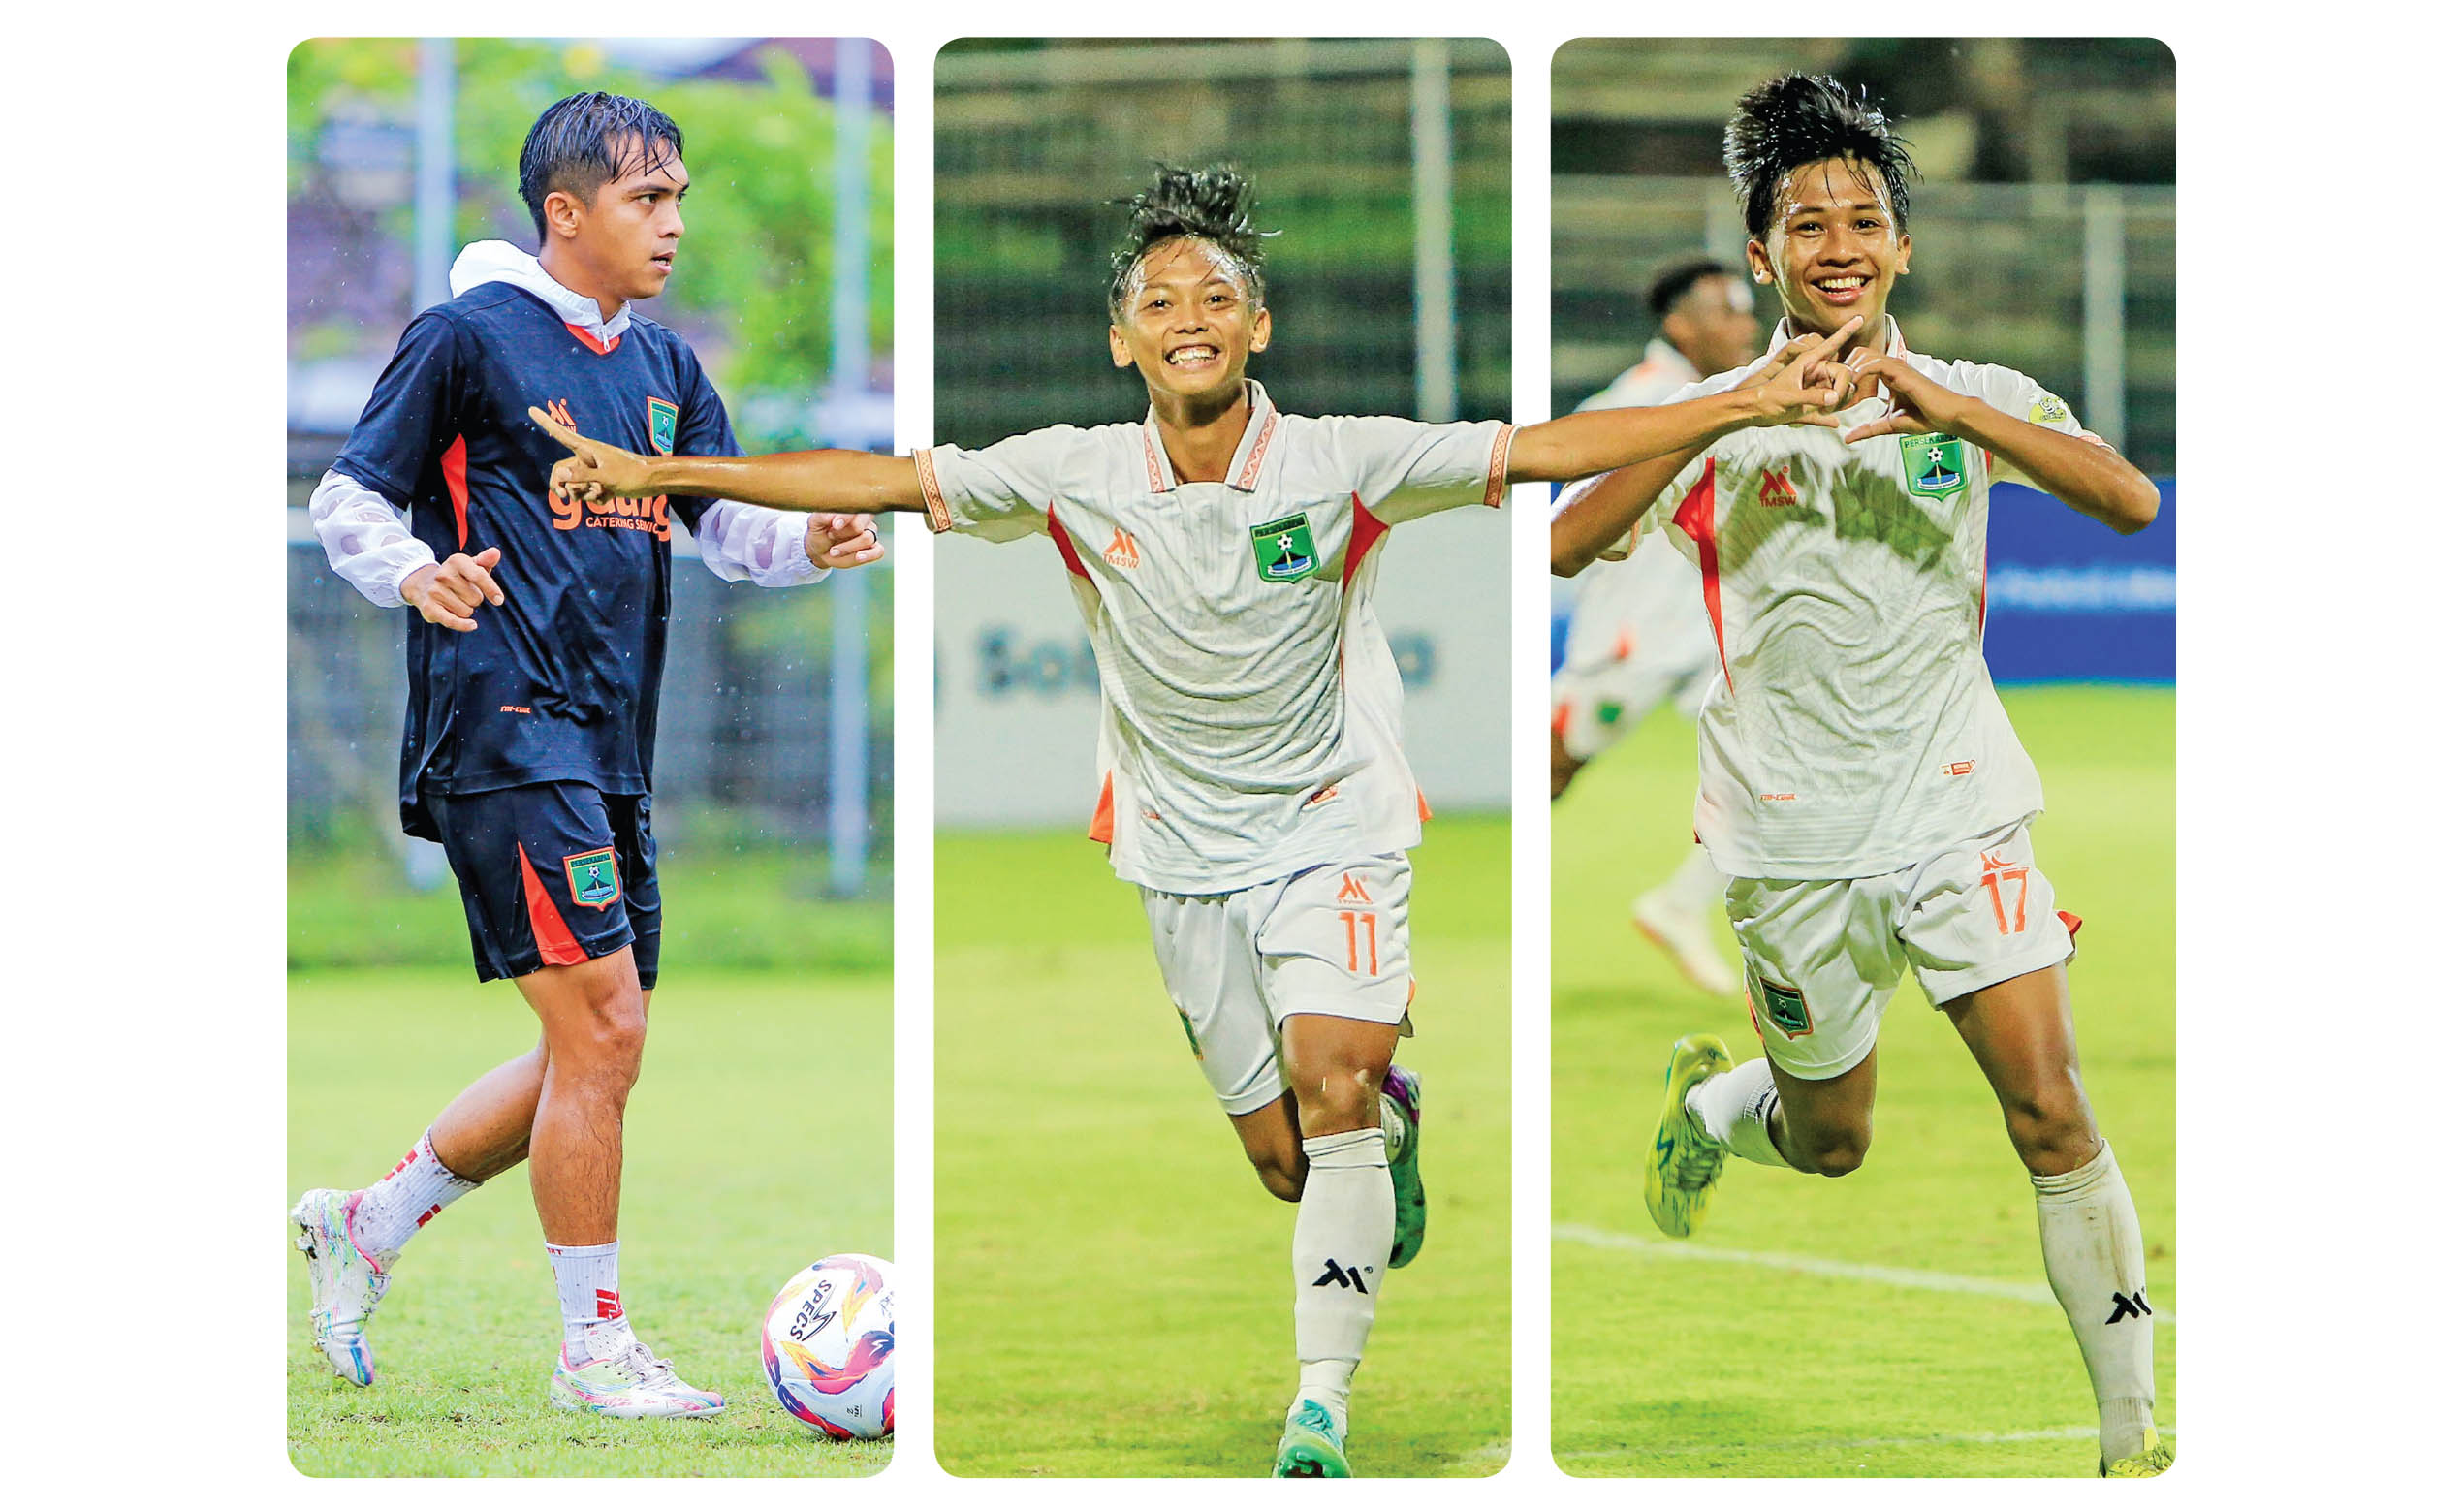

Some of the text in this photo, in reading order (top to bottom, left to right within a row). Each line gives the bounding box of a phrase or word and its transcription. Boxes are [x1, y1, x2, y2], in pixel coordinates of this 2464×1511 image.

[1979, 867, 2029, 935] 17
[1338, 912, 1376, 977] 11
[790, 1280, 832, 1340] SPECS
